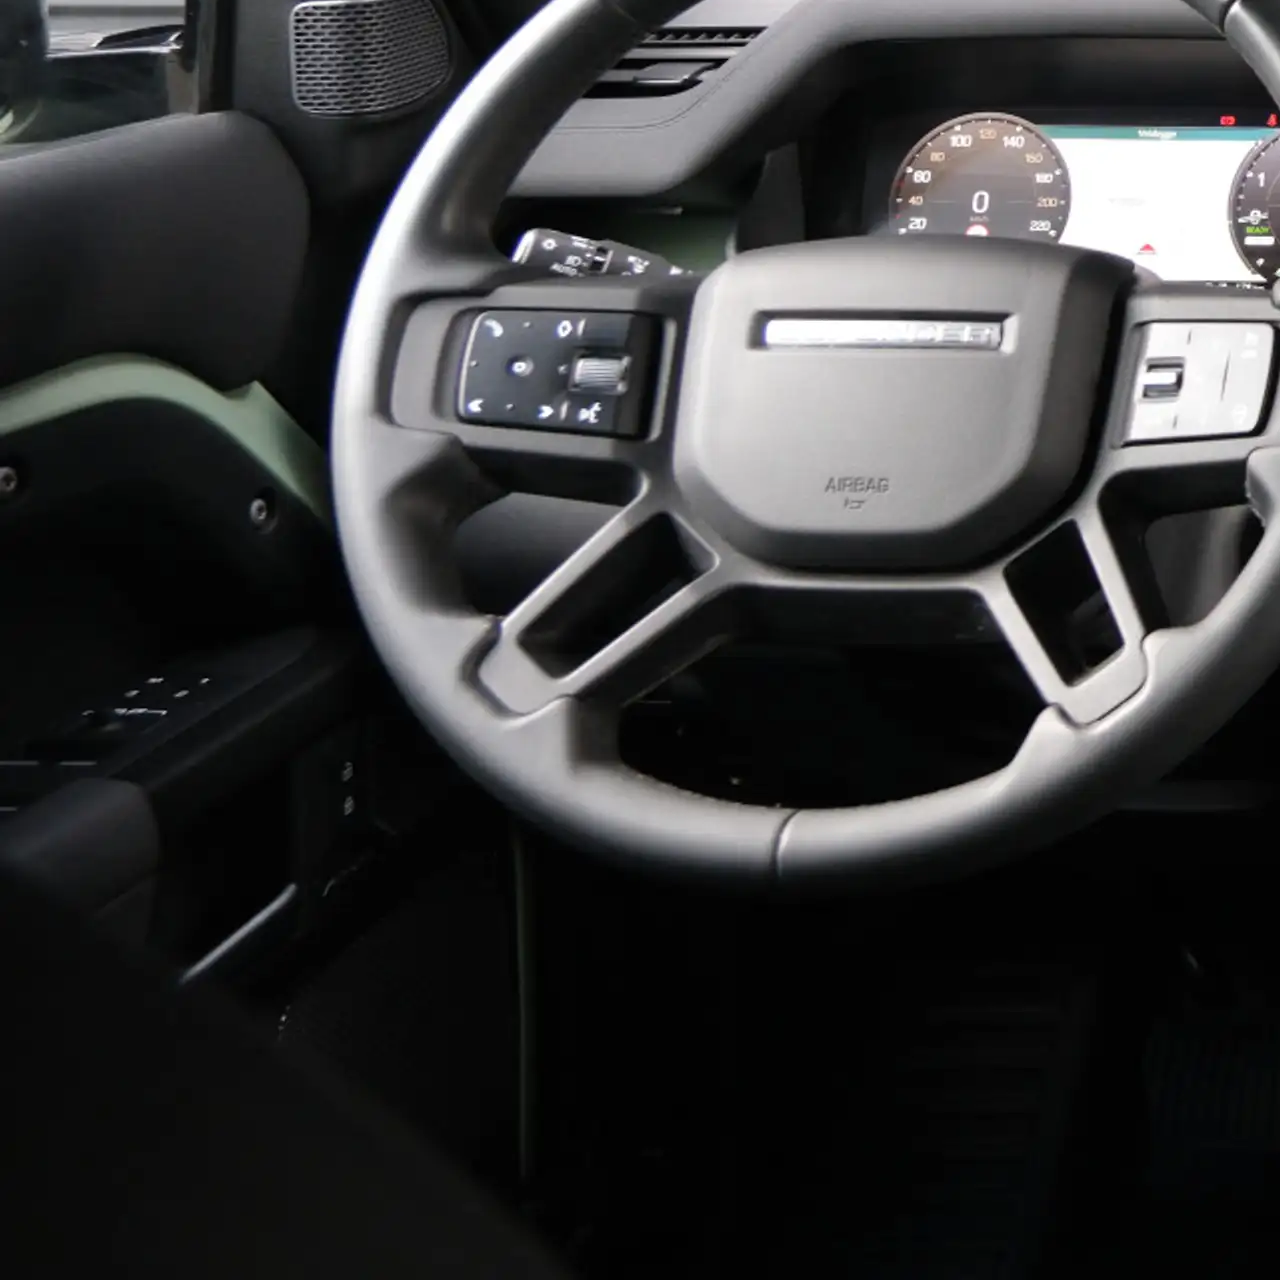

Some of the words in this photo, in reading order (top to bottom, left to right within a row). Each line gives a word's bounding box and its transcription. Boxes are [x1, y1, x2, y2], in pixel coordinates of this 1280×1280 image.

[950, 134, 972, 148] 100
[1002, 135, 1025, 148] 140
[913, 170, 931, 183] 60
[1257, 172, 1266, 188] 1
[908, 196, 923, 206] 40
[971, 190, 990, 214] 0
[908, 217, 927, 230] 20
[1029, 220, 1051, 232] 220
[824, 476, 890, 494] AIRBAG
